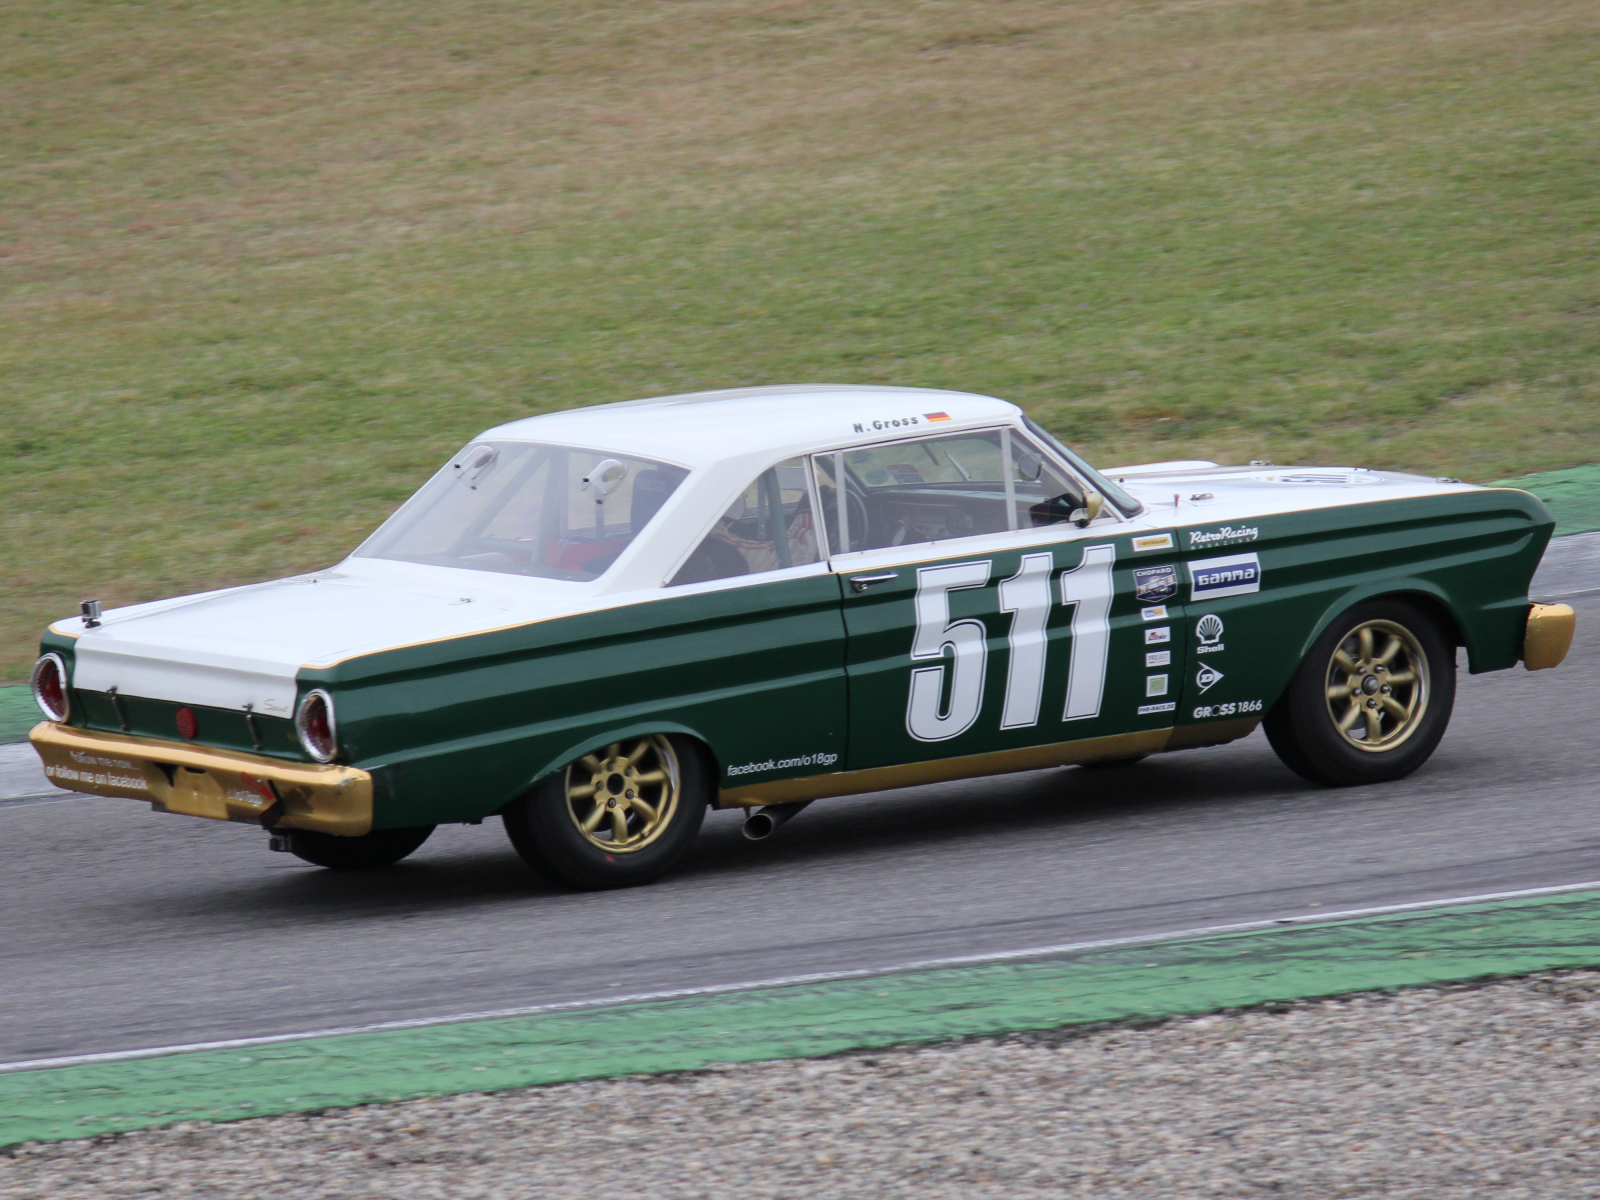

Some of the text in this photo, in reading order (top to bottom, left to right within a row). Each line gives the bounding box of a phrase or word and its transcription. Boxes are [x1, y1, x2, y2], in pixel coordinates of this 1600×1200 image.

[1189, 525, 1259, 544] RetroRacing
[1136, 567, 1172, 577] CHOPARD
[906, 543, 1116, 742] 511
[1196, 643, 1225, 654] Shell
[1193, 699, 1263, 719] GROSS 1866
[727, 752, 838, 776] facebook.com/o18gp
[45, 764, 149, 790] or follow me on facebook
